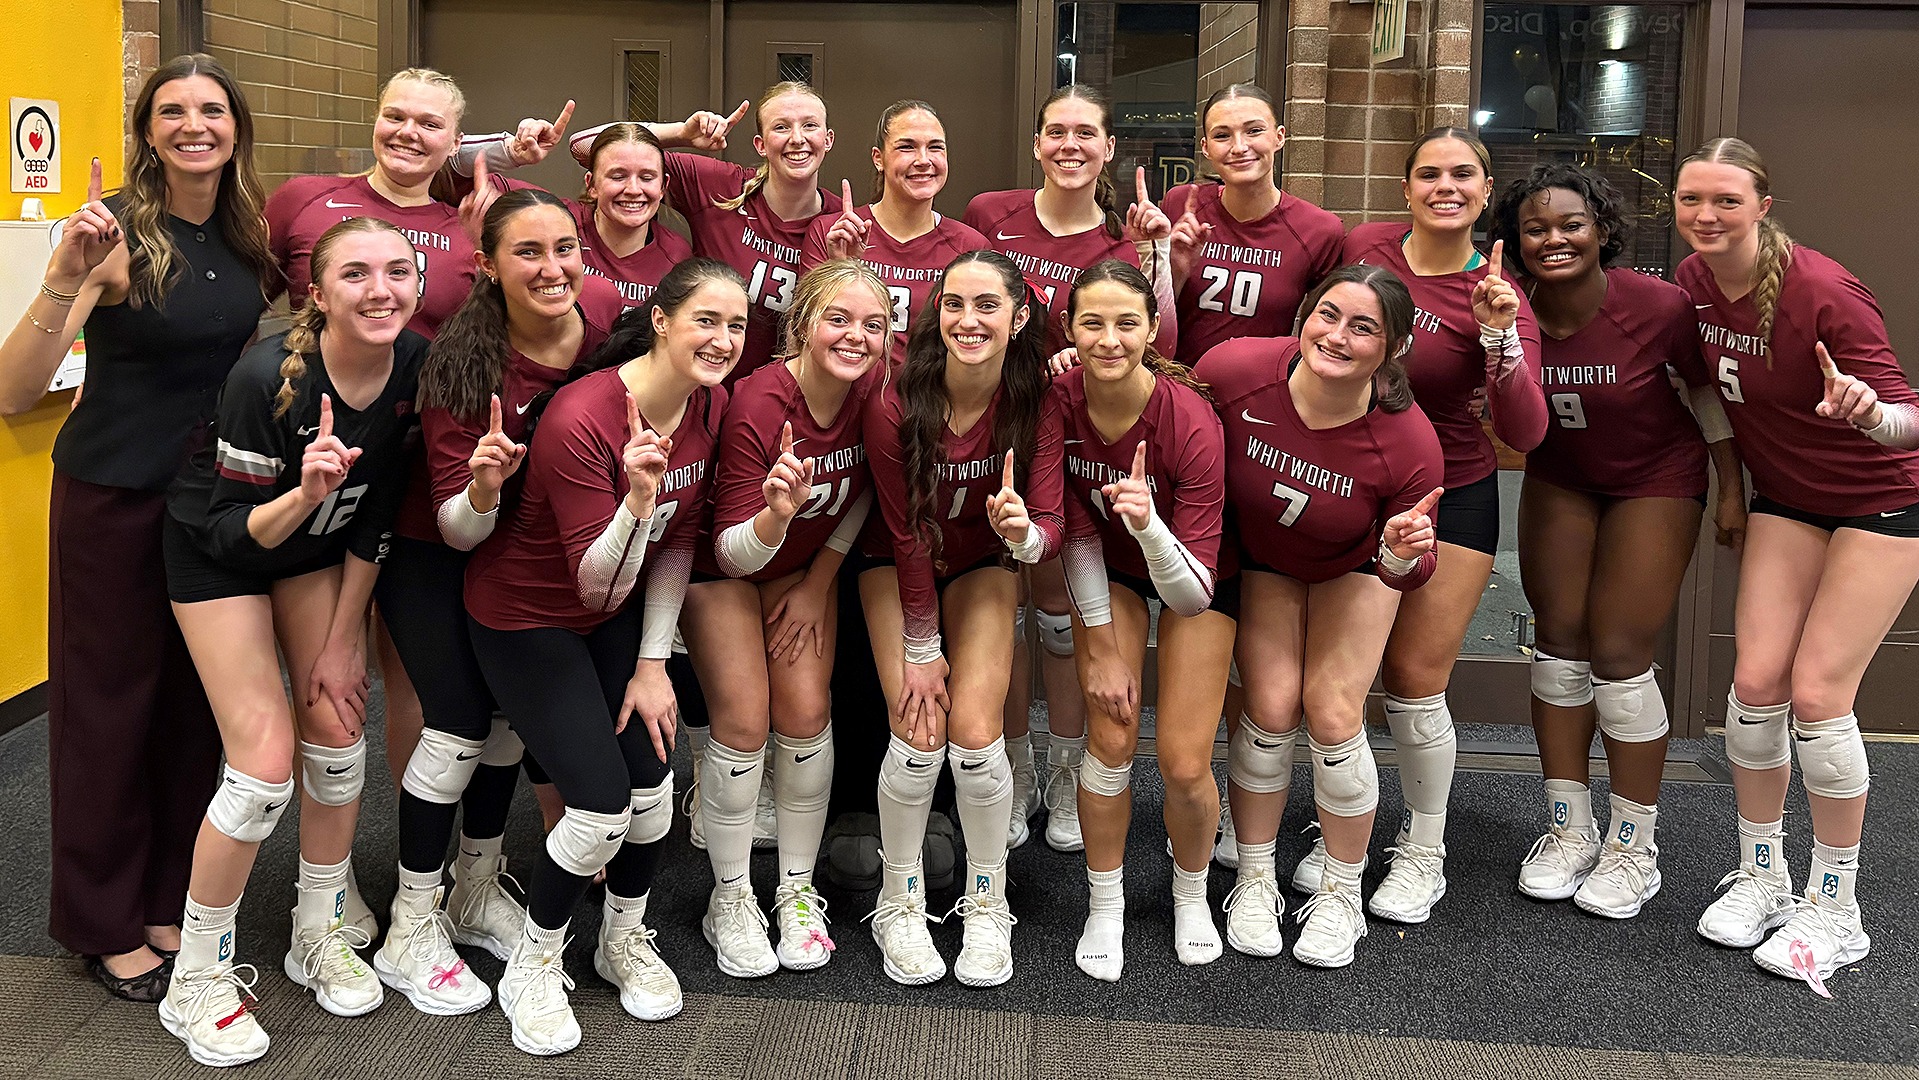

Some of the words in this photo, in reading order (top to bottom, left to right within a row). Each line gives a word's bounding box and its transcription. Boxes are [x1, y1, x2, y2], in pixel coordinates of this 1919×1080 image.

[25, 175, 48, 188] AED
[741, 226, 802, 265] WHITWOR
[1200, 241, 1282, 268] HITWORTH
[747, 259, 798, 313] 13
[1198, 265, 1263, 317] 20
[1540, 364, 1617, 385] ITWORTH
[1718, 355, 1745, 404] 5
[1550, 392, 1588, 429] 9
[1246, 434, 1354, 498] WHITWORTH
[308, 483, 369, 536] 12
[795, 476, 851, 519] 21
[947, 486, 968, 520] 1
[1271, 481, 1312, 527] 7
